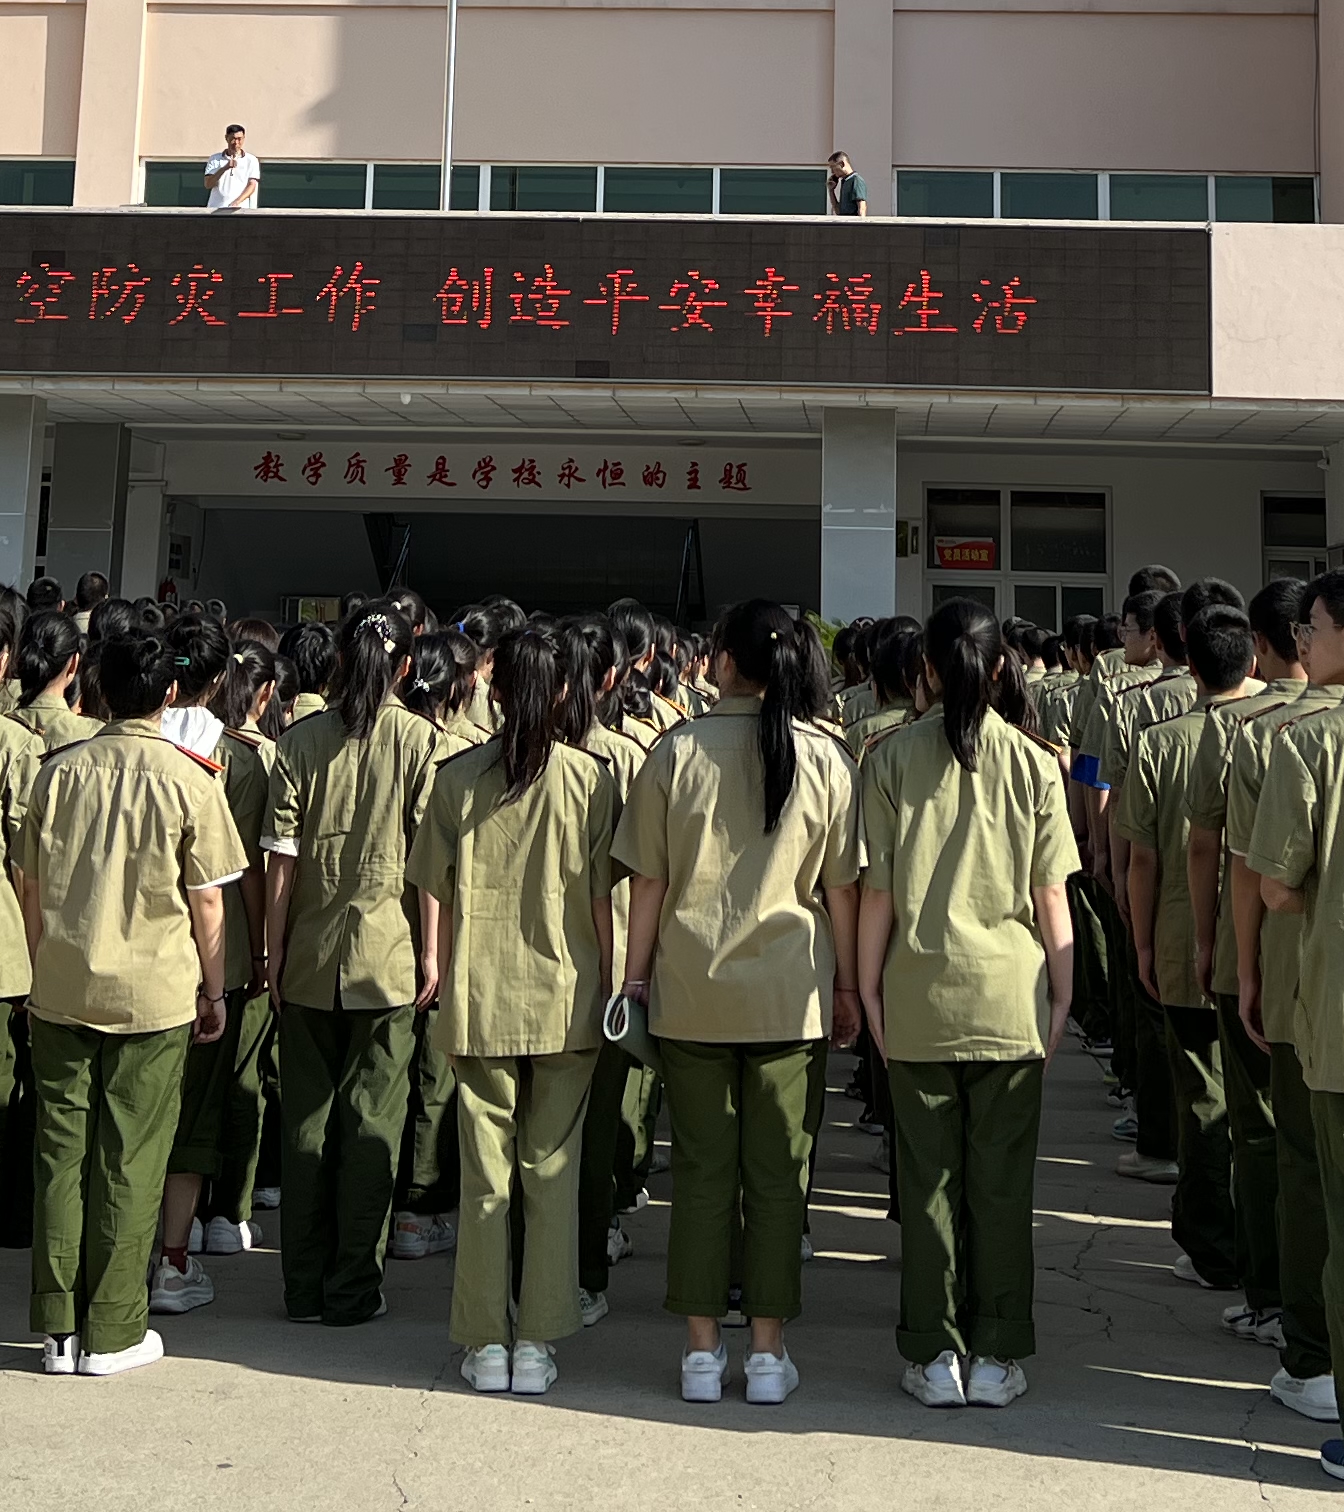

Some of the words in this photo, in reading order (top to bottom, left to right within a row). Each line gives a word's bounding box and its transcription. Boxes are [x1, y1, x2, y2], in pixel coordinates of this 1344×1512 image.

[433, 263, 1038, 337] 创造平安幸福生活
[253, 451, 753, 492] 教学质量是学校永恒的主题
[943, 548, 989, 562] 党员活动室
